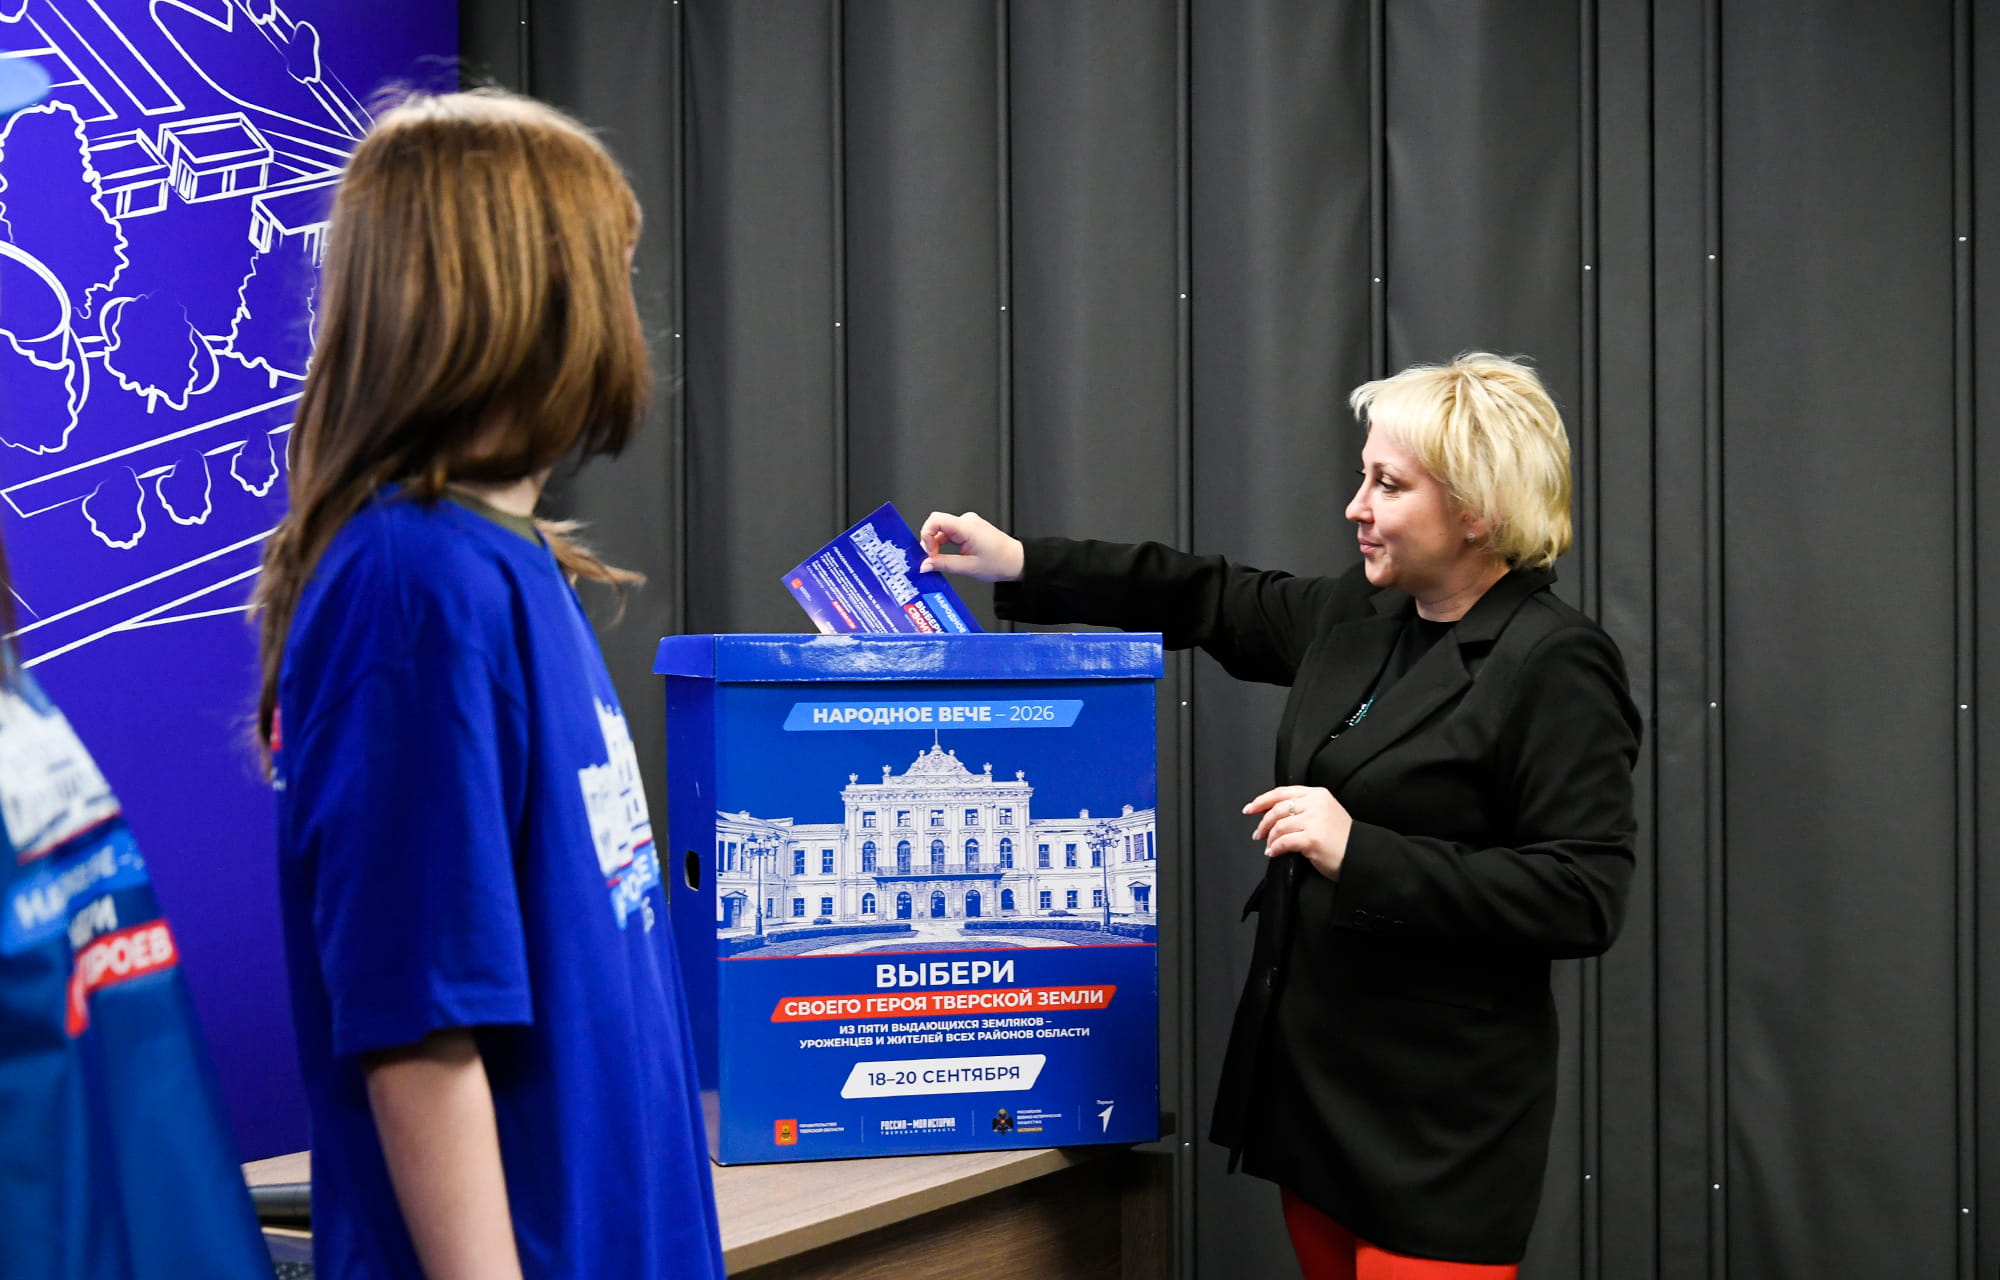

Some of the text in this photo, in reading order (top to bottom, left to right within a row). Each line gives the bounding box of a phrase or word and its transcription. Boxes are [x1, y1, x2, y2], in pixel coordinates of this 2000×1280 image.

[813, 706, 933, 725] НАРОДНОЕ
[938, 706, 992, 723] ВЕЧЕ
[1009, 705, 1055, 722] 2026
[875, 959, 1015, 989] ВЫБЕРИ
[784, 989, 1104, 1017] СВОЕГО ГЕРОЯ ТВЕРСКОЙ ЗЕМЛИ
[839, 1025, 855, 1035] ИЗ
[857, 1023, 888, 1034] ПЯТИ
[891, 1020, 980, 1034] ВЫДАЮЩИХСЯ
[981, 1017, 1044, 1030] ЗЕМЛЯКОВ
[799, 1027, 1090, 1049] УРОЖЕНЦЕВ И ЖИТЕЛЕЙ ВСЕХ РАЙОНОВ ОБЛАСТИ
[867, 1066, 1021, 1086] 18–20 СЕНТЯБРЯ
